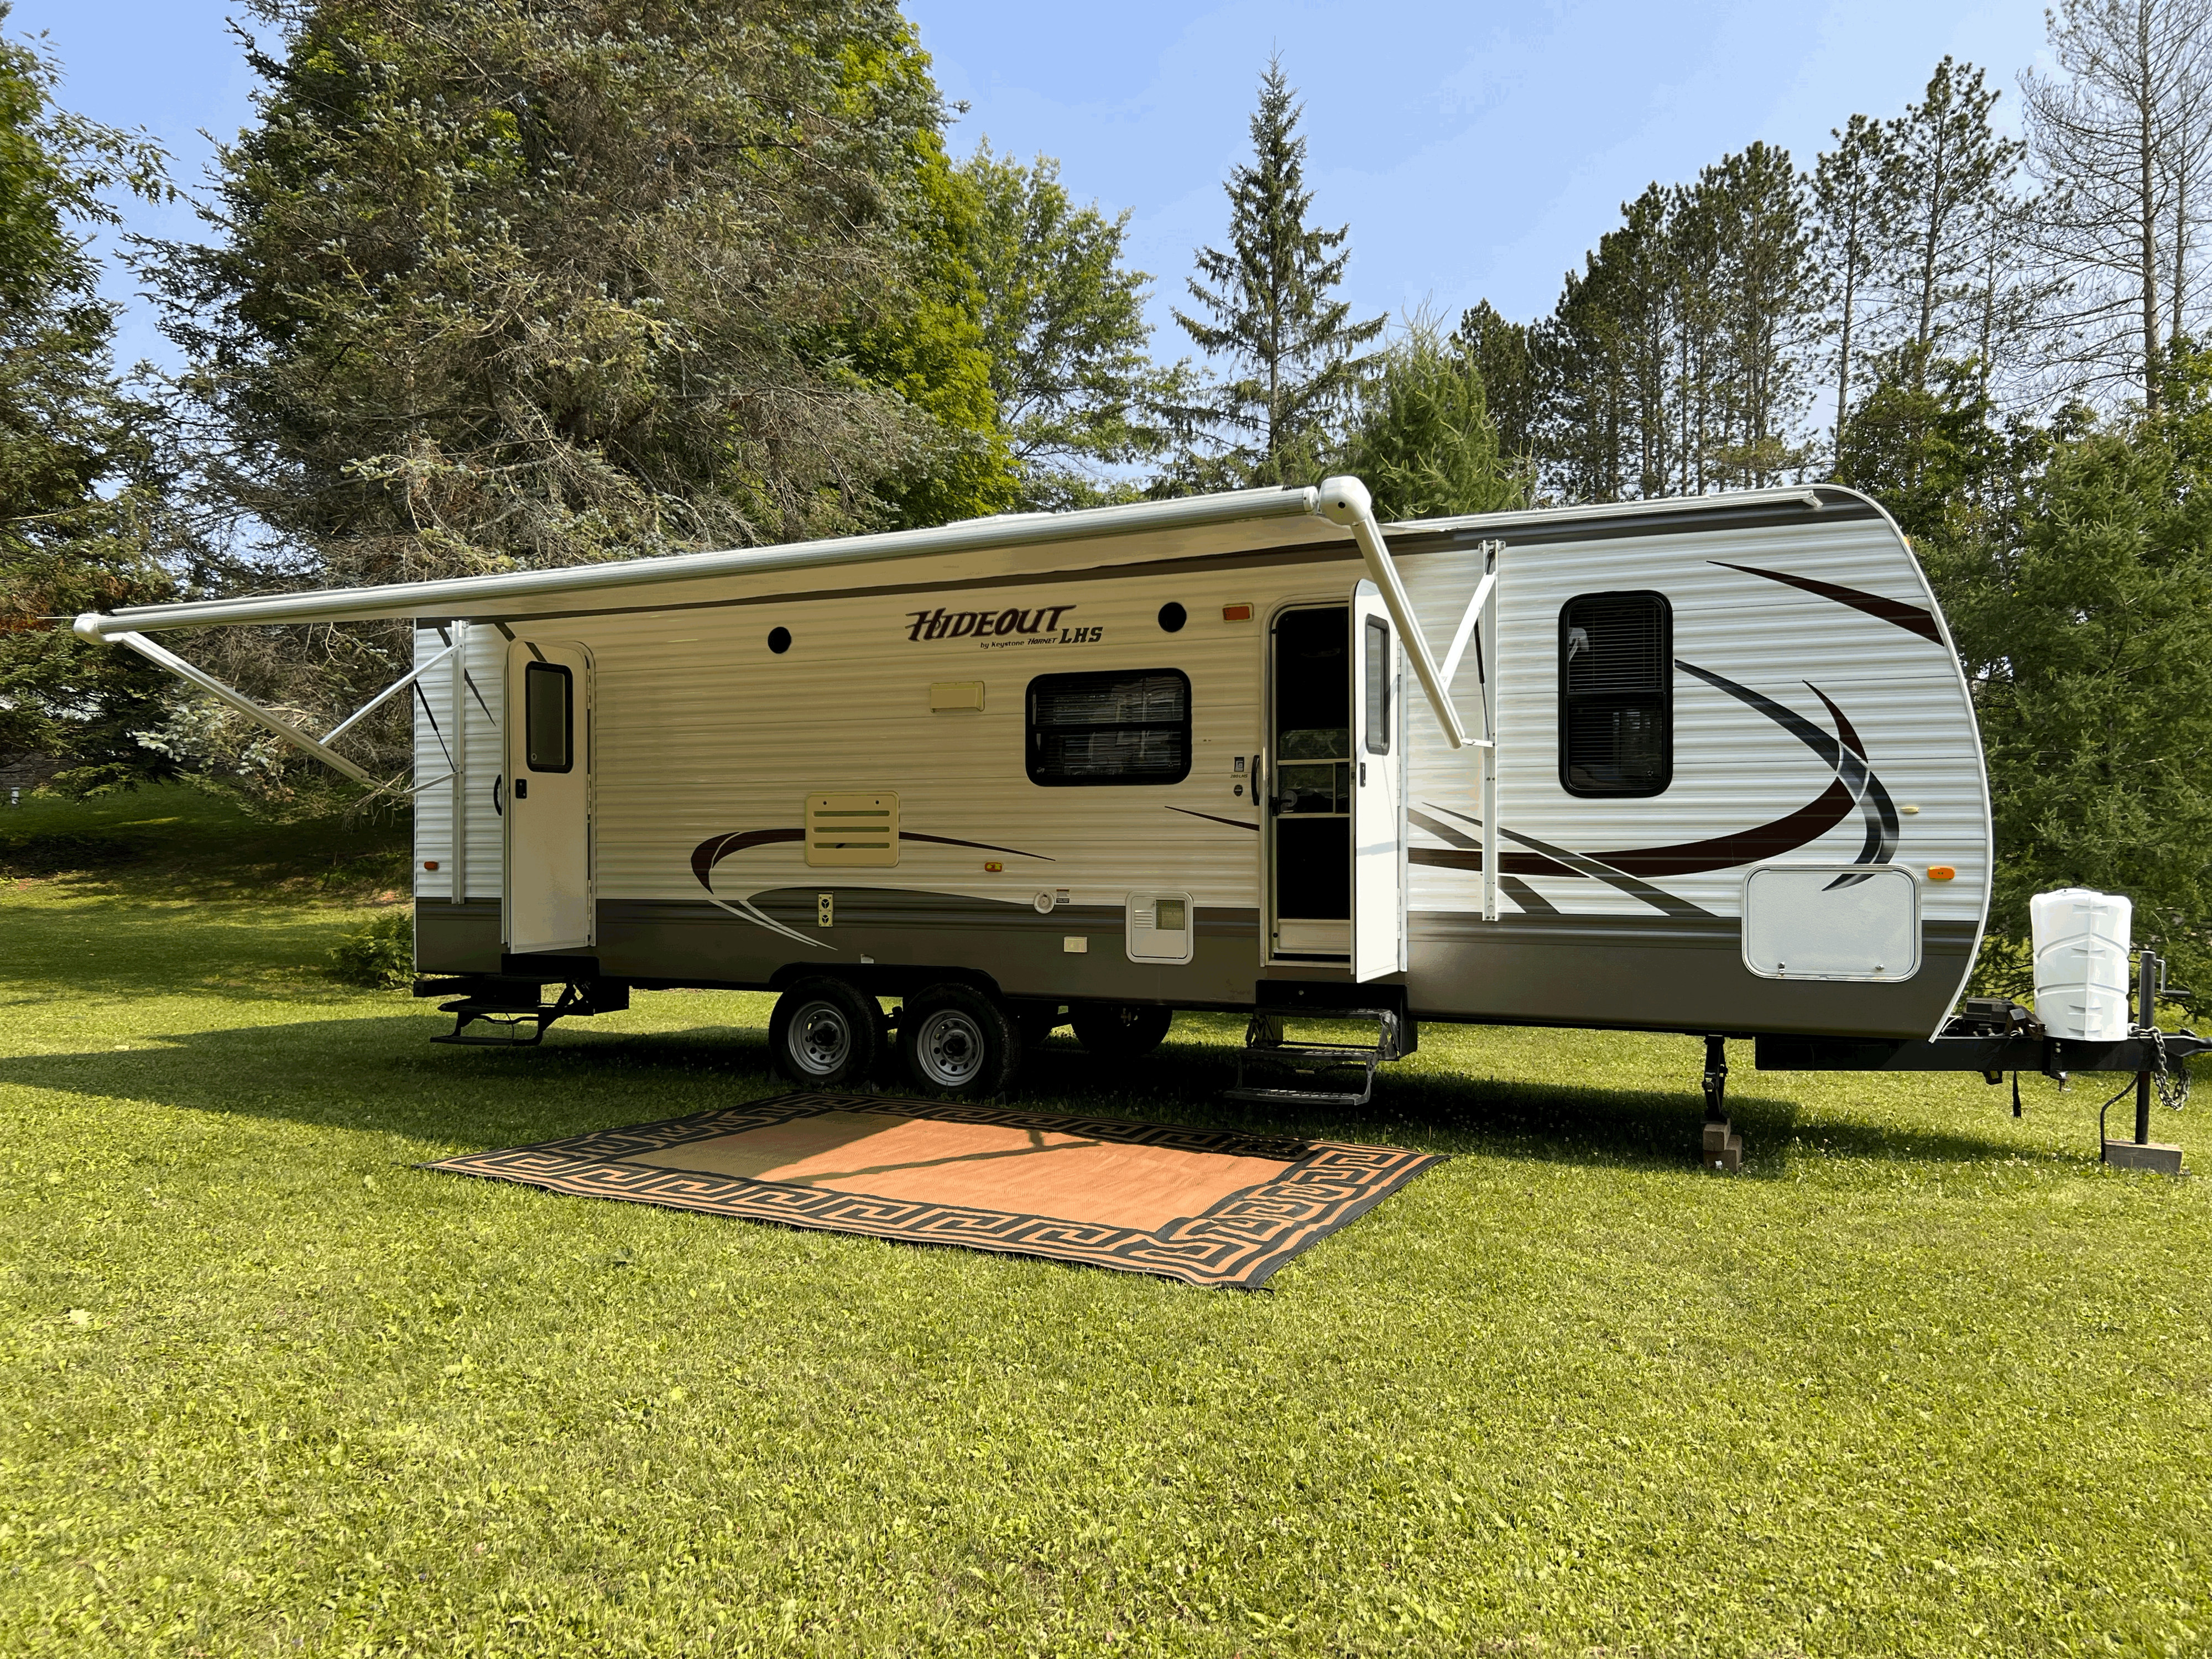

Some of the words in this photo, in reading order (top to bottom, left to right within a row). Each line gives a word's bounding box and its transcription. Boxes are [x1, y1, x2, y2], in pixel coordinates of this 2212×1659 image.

[905, 604, 1077, 642] HIDEOUT
[1058, 627, 1103, 644] LHS
[991, 640, 1024, 649] Keystone
